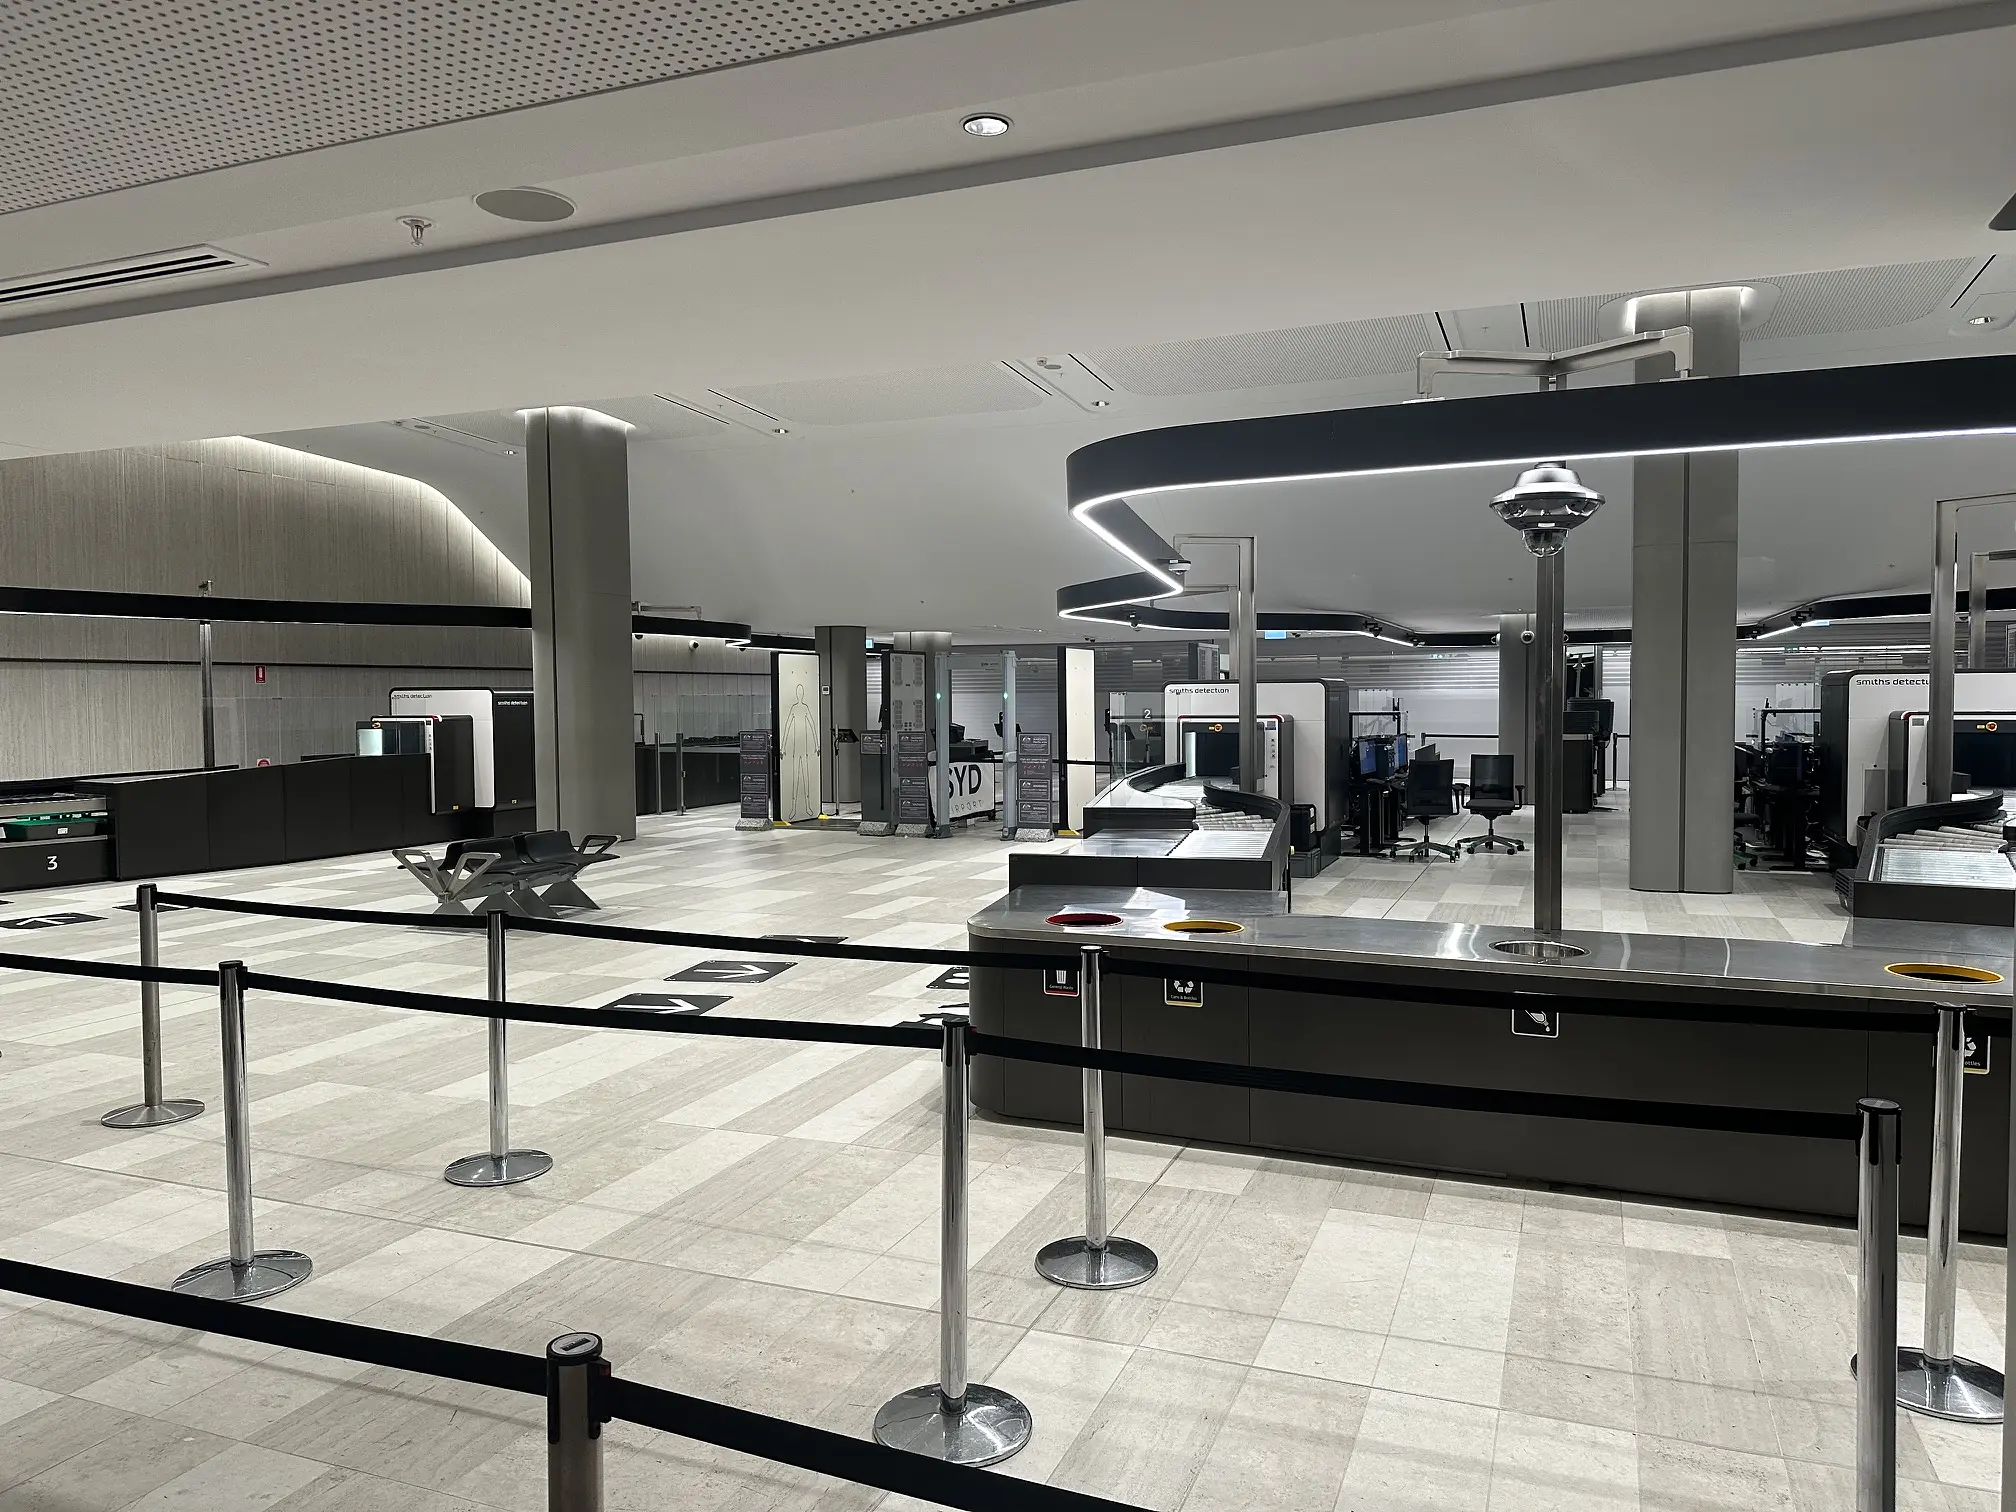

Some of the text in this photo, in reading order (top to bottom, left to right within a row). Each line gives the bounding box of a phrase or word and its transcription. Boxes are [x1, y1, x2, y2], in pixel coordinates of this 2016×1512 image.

[1144, 709, 1151, 719] 2
[951, 800, 983, 813] IRPORT
[47, 855, 58, 871] 3
